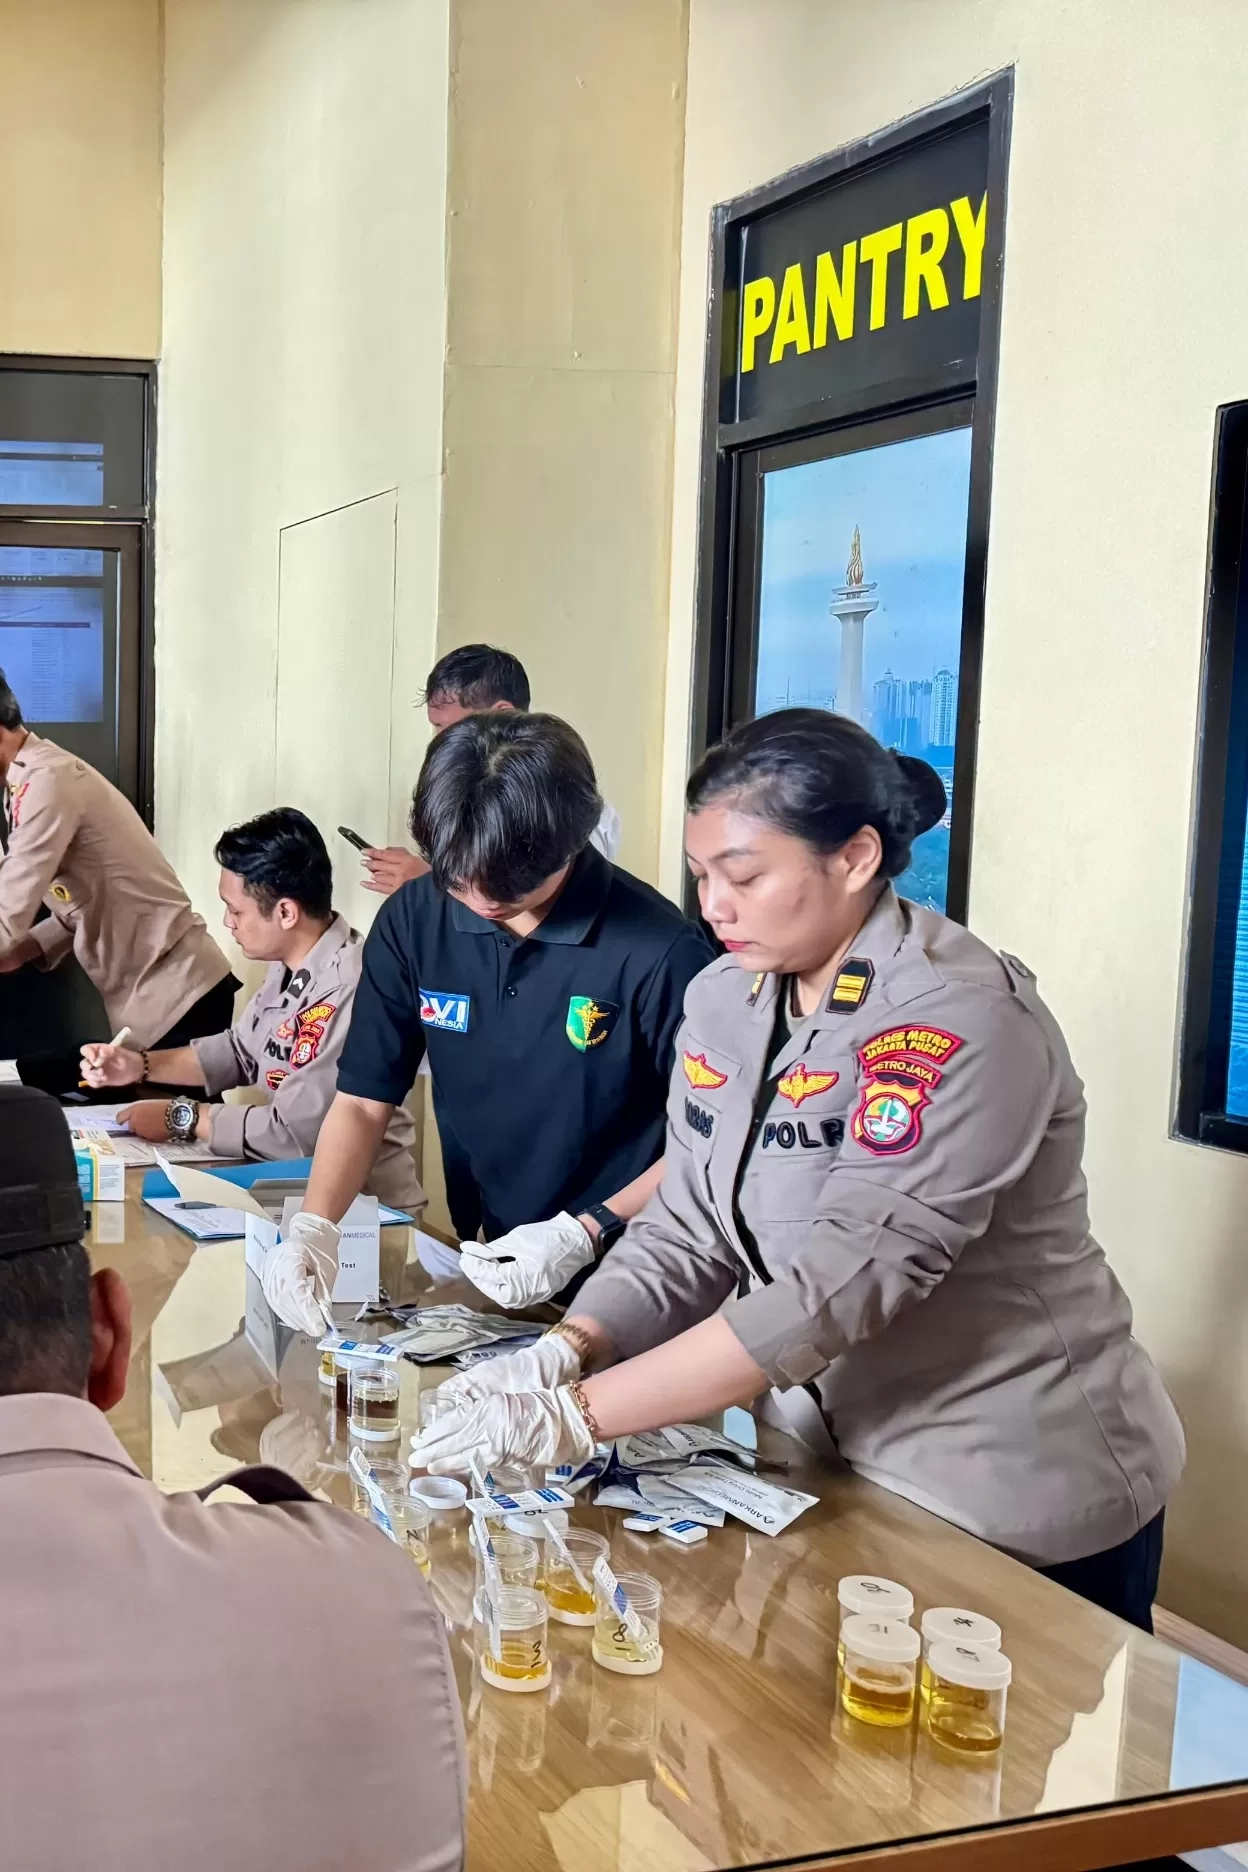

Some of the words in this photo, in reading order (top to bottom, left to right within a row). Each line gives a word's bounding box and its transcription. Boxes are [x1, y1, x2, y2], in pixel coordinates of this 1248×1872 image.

[741, 189, 988, 373] PANTRY
[435, 1018, 463, 1029] NESIA
[907, 1030, 952, 1049] METRO
[866, 1041, 907, 1060] JAKARTA
[909, 1041, 946, 1057] PUSAT
[869, 1061, 906, 1072] METRO
[907, 1064, 934, 1083] JAYA
[612, 1623, 628, 1642] 8
[532, 1640, 542, 1661] 3
